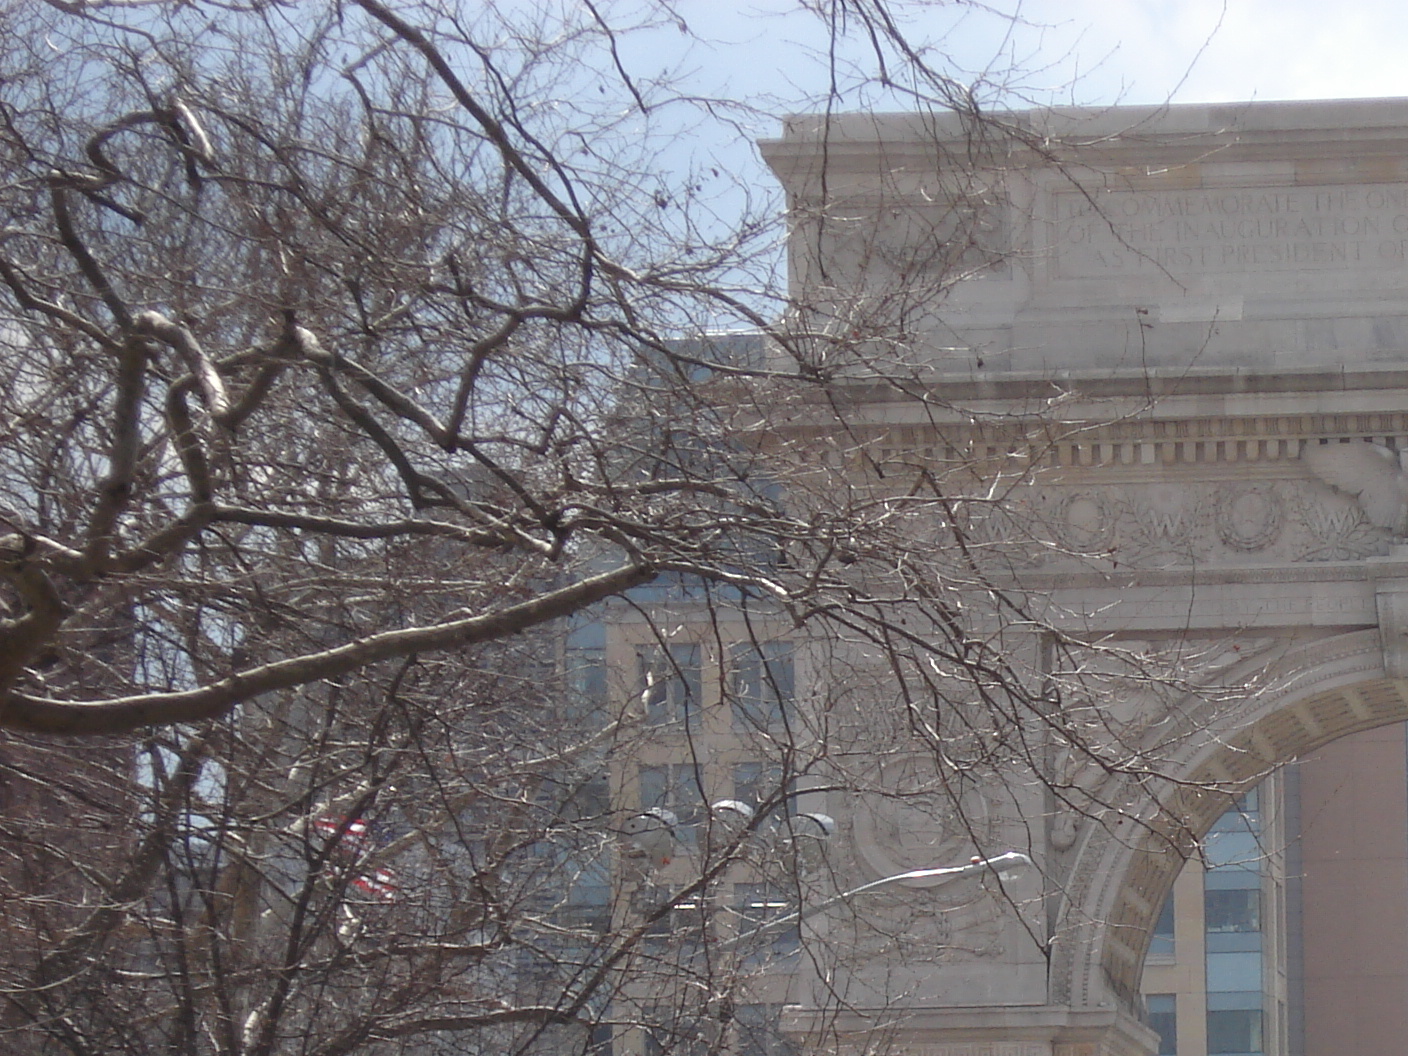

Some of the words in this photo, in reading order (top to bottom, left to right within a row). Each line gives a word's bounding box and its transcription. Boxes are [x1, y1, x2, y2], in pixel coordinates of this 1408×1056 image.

[1312, 189, 1358, 211] THE
[1067, 222, 1100, 244] OF
[1118, 220, 1164, 242] THE
[1176, 216, 1379, 242] INAUGURATION
[1097, 249, 1124, 268] AS
[1138, 245, 1211, 268] FIRST
[1221, 240, 1364, 266] PRESIDENT
